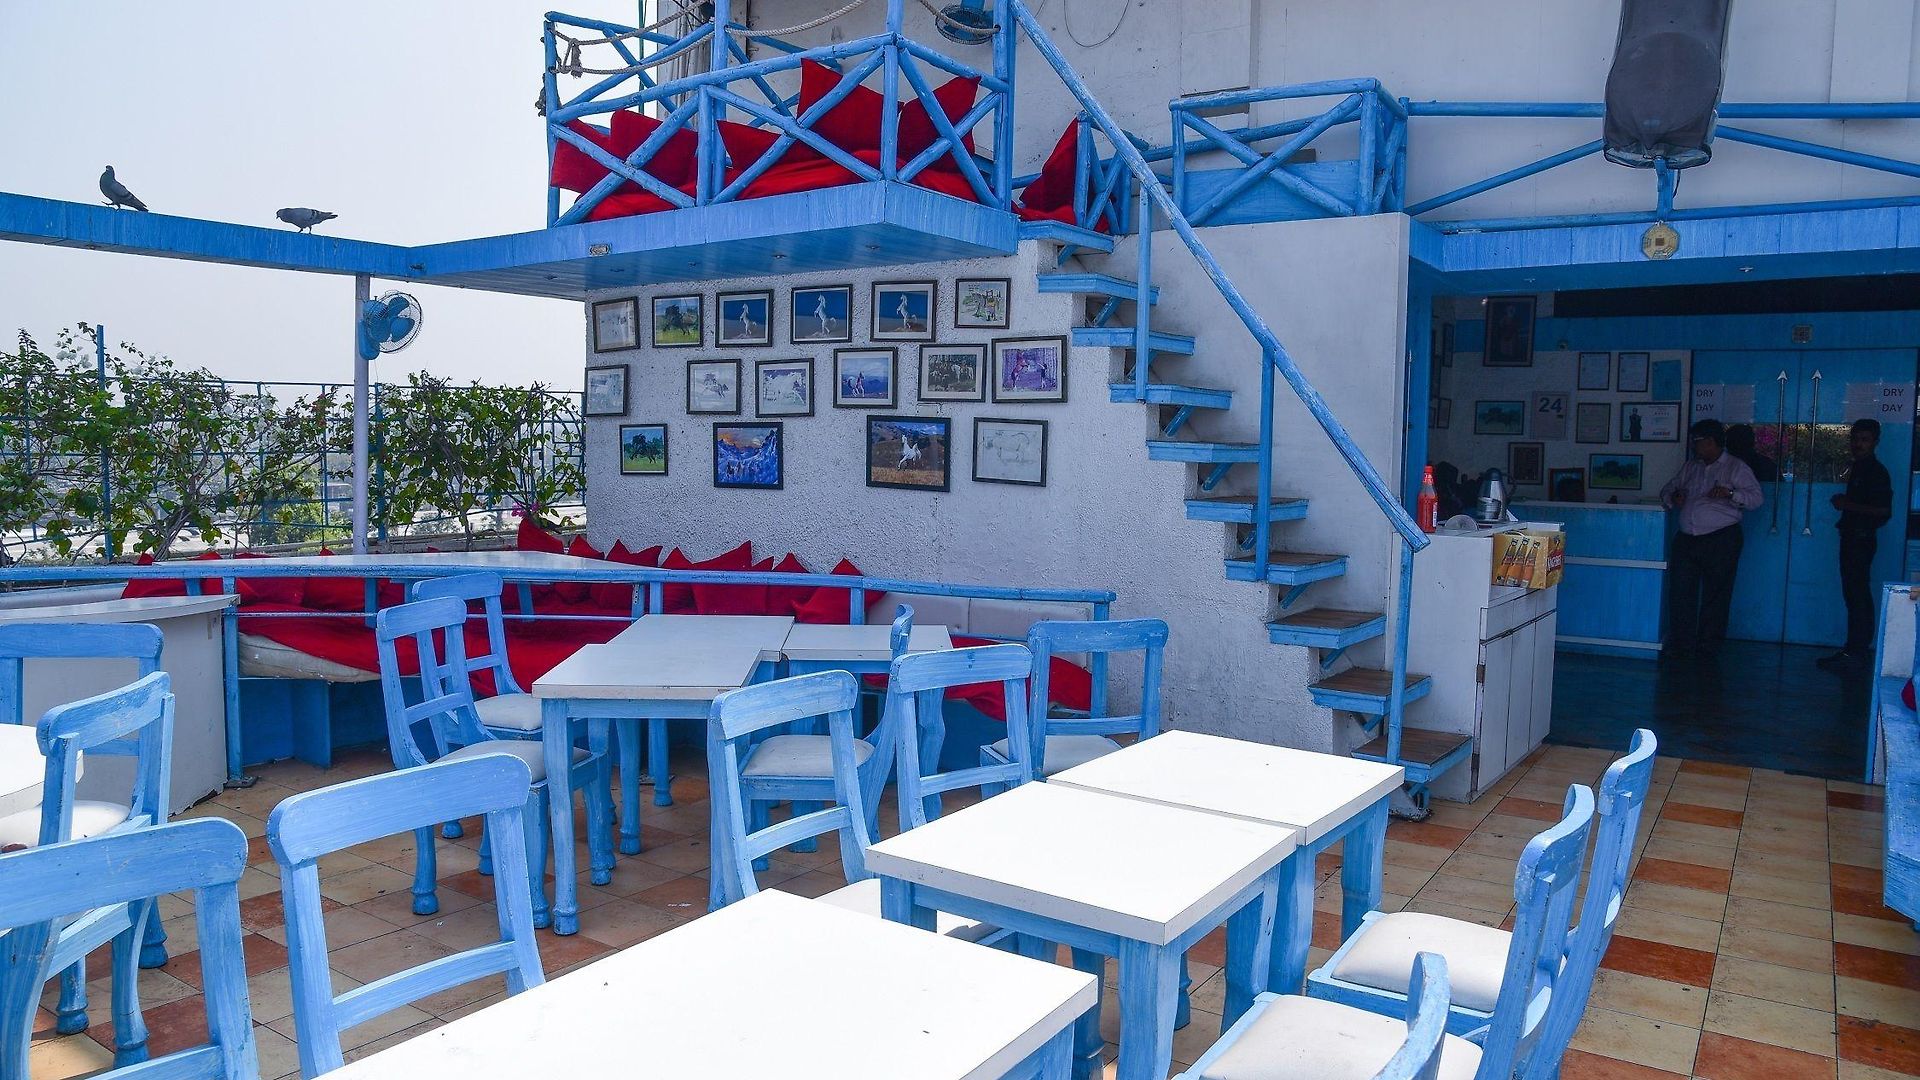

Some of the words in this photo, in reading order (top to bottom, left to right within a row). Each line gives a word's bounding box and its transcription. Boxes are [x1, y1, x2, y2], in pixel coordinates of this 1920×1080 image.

[1697, 389, 1714, 397] DRY
[1883, 388, 1904, 397] DRY
[1539, 397, 1562, 413] 24
[1695, 403, 1714, 412] DAY
[1882, 403, 1903, 412] DAY
